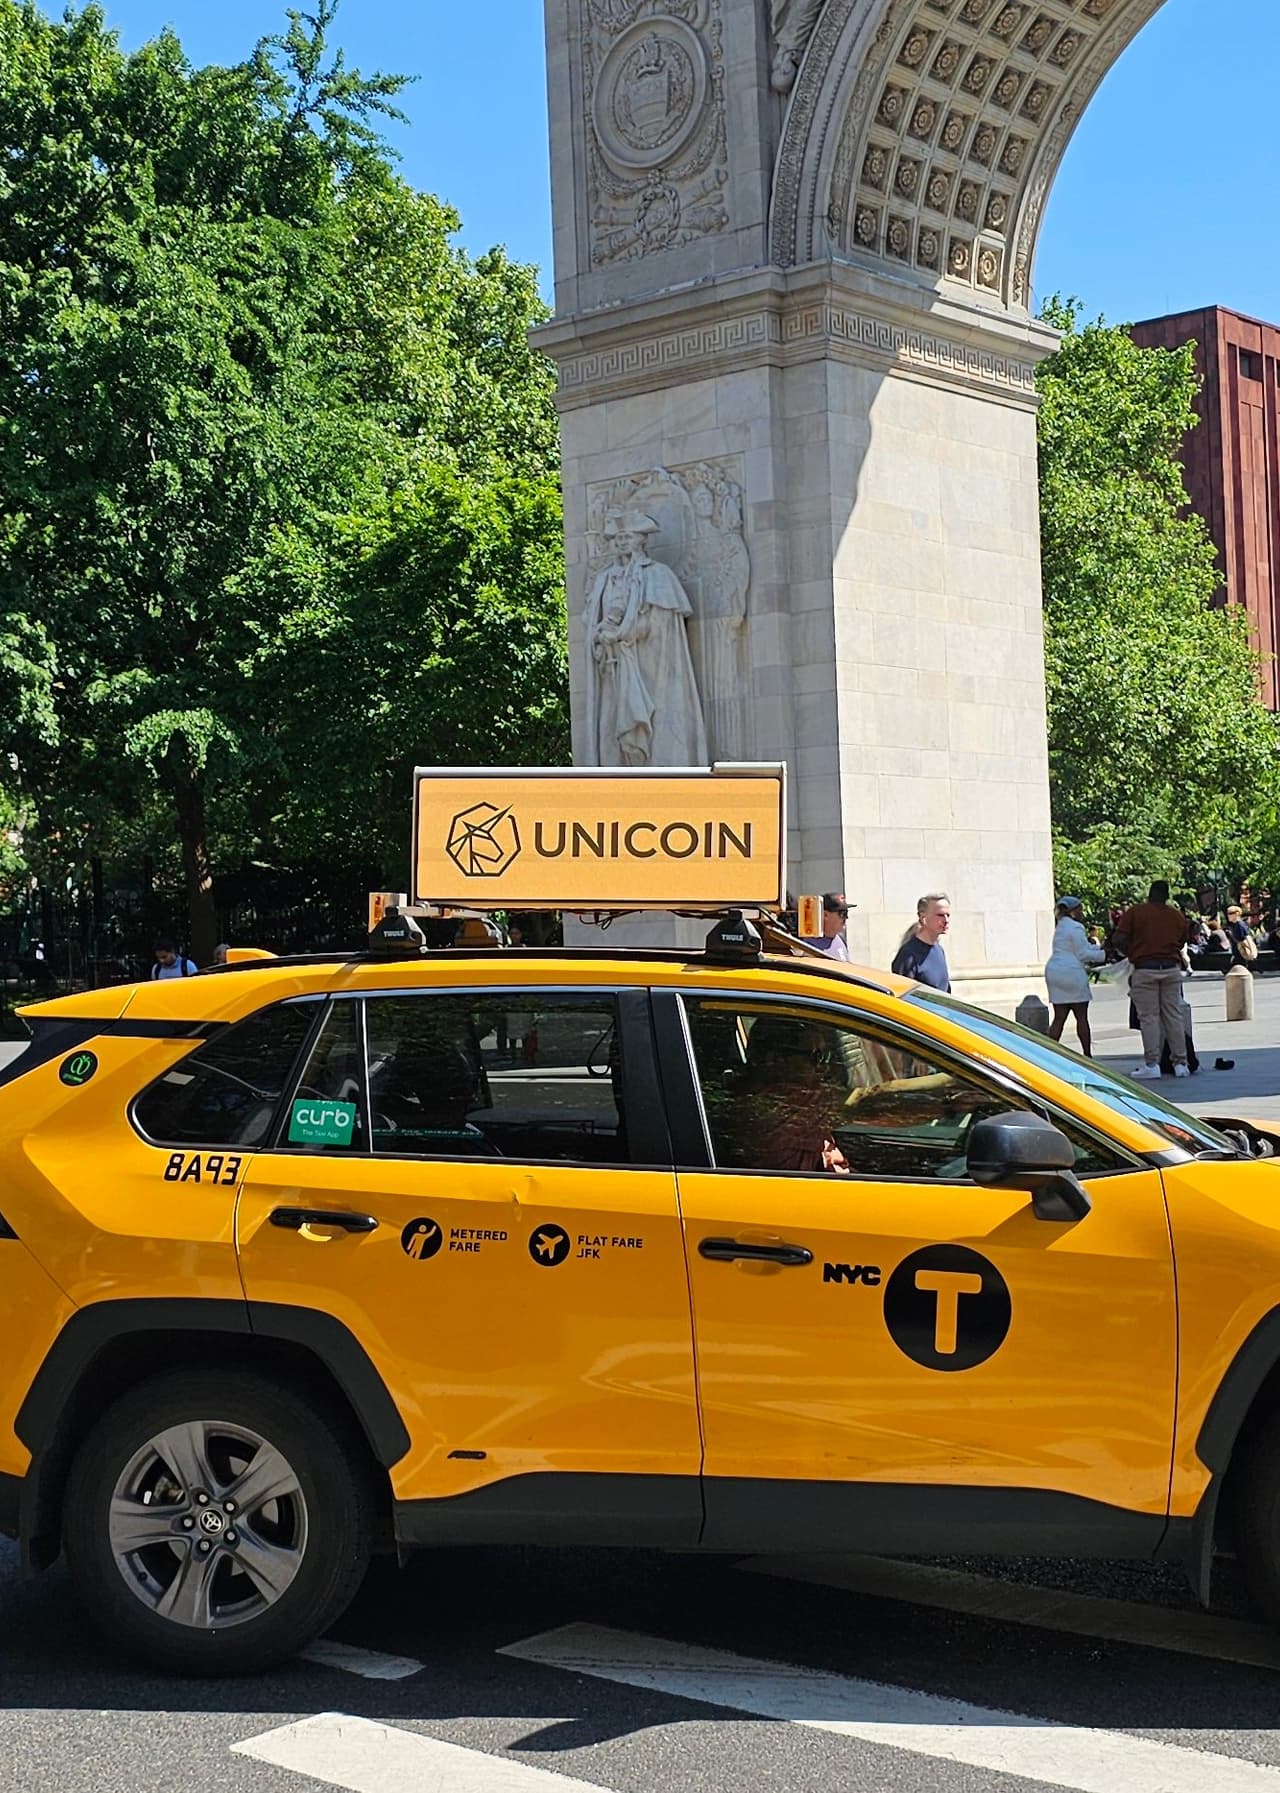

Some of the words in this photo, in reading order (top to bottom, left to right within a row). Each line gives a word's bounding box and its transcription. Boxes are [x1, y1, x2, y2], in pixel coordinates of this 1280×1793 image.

[534, 821, 752, 859] UNICOIN
[721, 934, 744, 942] THULE
[296, 1109, 350, 1127] curb
[164, 1153, 242, 1186] 8A93
[450, 1228, 508, 1241] METERED
[449, 1241, 481, 1252] FARE
[577, 1235, 608, 1246] FLAT
[611, 1237, 643, 1248] FARE
[576, 1248, 600, 1259] JFK
[823, 1263, 881, 1286] NYC
[914, 1269, 983, 1355] T
